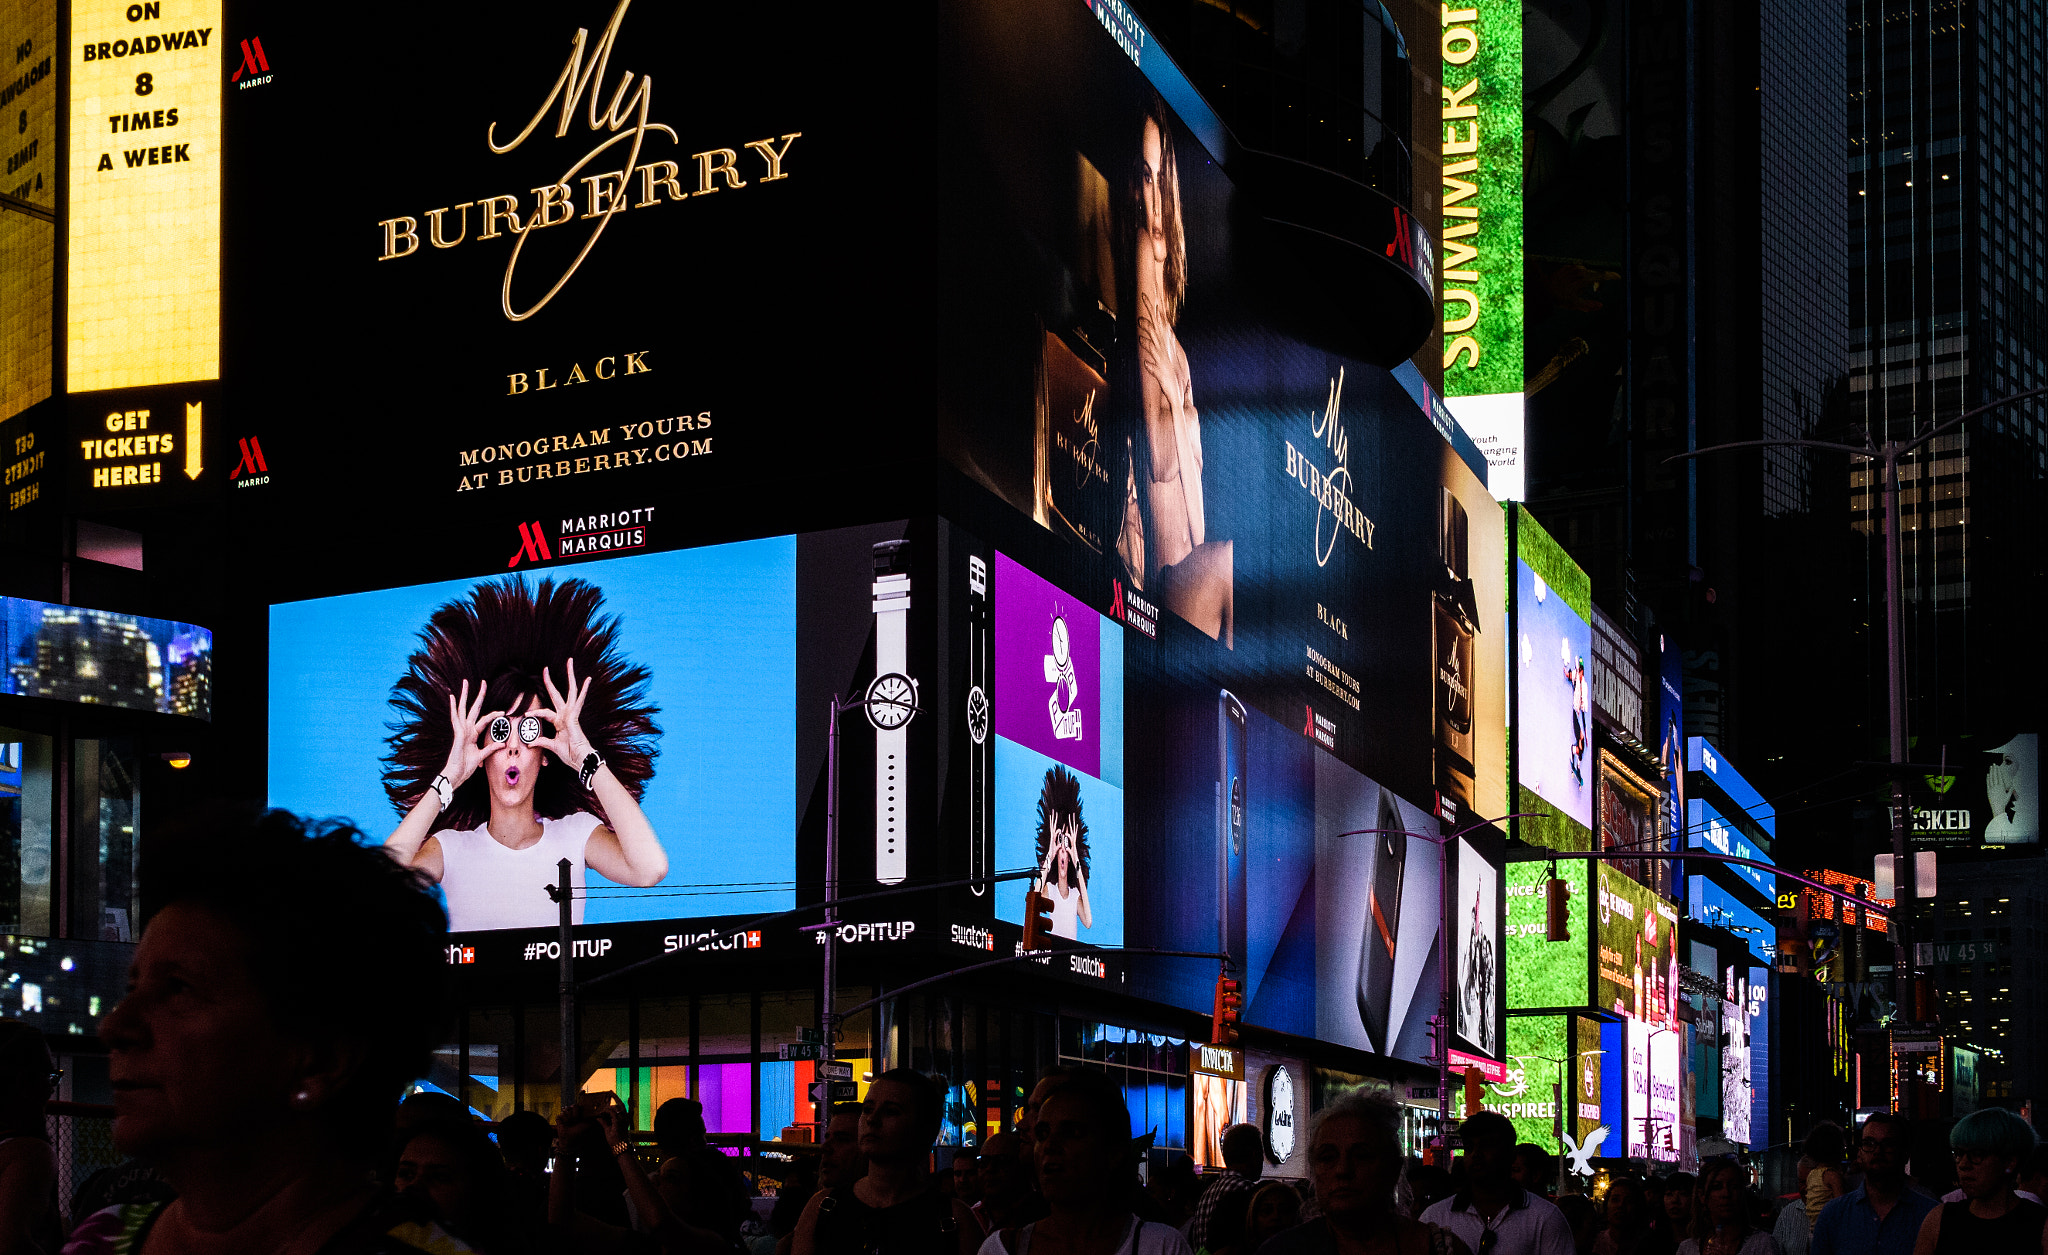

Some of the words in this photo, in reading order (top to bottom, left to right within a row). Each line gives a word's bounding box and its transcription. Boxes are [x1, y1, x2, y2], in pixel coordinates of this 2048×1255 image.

[126, 1, 160, 22] ON
[1105, 0, 1145, 48] RRIOTT
[83, 28, 212, 62] BROADWAY
[1097, 3, 1140, 68] MARQUIS
[135, 72, 153, 96] 8
[239, 75, 274, 90] MARRIO
[109, 108, 179, 133] TIMES
[97, 153, 114, 172] A
[124, 144, 190, 168] WEEK
[488, 0, 678, 321] My
[378, 131, 802, 262] BURBERRY
[1442, 77, 1480, 370] SUMMER
[506, 350, 652, 396] BLACK
[105, 409, 150, 432] GET
[81, 433, 174, 460] TICKETS
[459, 427, 611, 467] MONOGRAM
[620, 411, 713, 441] YOURS
[93, 461, 161, 488] HERE!
[457, 473, 489, 492] AT
[498, 437, 713, 486] BURBERRY.COM
[1311, 365, 1353, 567] My
[1285, 440, 1375, 550] BURBERRY
[561, 507, 655, 534] MARRIOTT
[561, 529, 643, 555] MARQUIS
[1127, 590, 1159, 620] MARRIOTT
[1127, 609, 1157, 637] MARQUIS
[1317, 602, 1349, 640] BLACK
[1306, 645, 1340, 680] MONOGRAM
[1341, 671, 1360, 694] YOURS
[1506, 883, 1533, 897] vice
[664, 931, 748, 953] swatch
[951, 924, 988, 950] swatch
[1519, 923, 1548, 938] you
[524, 939, 612, 961] #POITUP
[1937, 945, 1950, 961] W
[1958, 943, 1976, 961] 45
[1983, 942, 1993, 954] St
[1070, 955, 1100, 977] swatch
[789, 1046, 798, 1058] W
[801, 1045, 812, 1057] 45
[1201, 1046, 1234, 1073] INVICTA
[838, 1067, 851, 1077] WAY
[1484, 1102, 1556, 1118] INSPIRED
